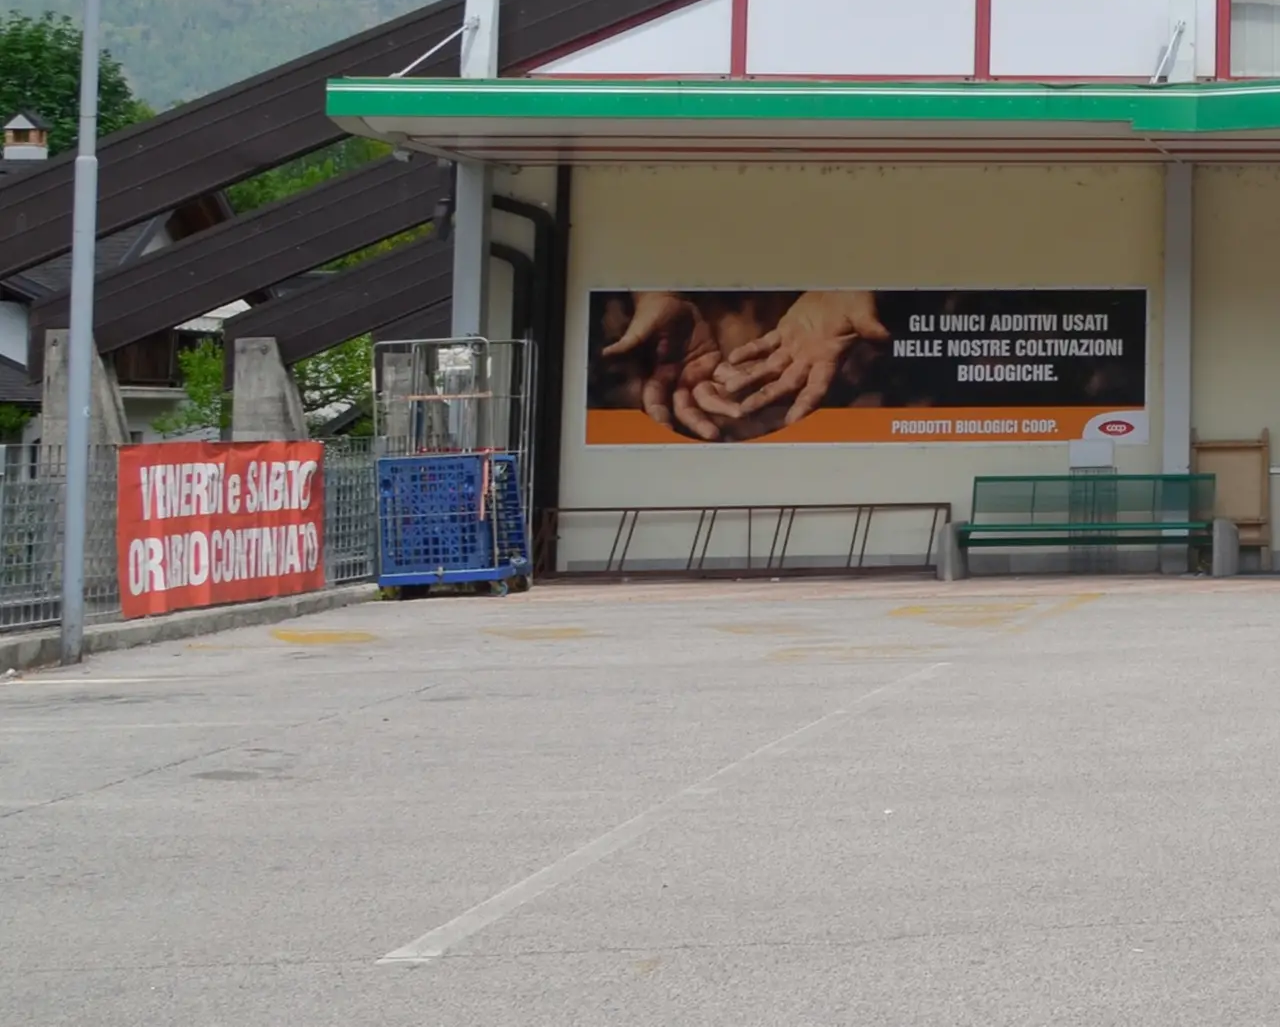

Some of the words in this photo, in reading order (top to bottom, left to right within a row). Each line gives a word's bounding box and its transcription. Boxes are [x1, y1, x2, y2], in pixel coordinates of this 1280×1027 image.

[909, 314, 935, 332] GLI
[940, 314, 986, 332] UNICI
[990, 314, 1058, 331] ADDITIVI
[1063, 314, 1109, 331] USATI
[893, 340, 943, 357] NELLE
[947, 340, 1011, 357] NOSTRE
[1015, 339, 1124, 356] COLTIVAZIONI
[957, 364, 1059, 382] BIOLOGICHE.
[892, 421, 952, 434] PRODOTTI
[956, 420, 1018, 434] BIOLOGICI
[1022, 420, 1059, 433] COOP.
[1106, 424, 1127, 434] coop
[228, 474, 241, 514] e
[129, 530, 209, 596] ORARIO
[211, 521, 319, 584] CONTINUATO
